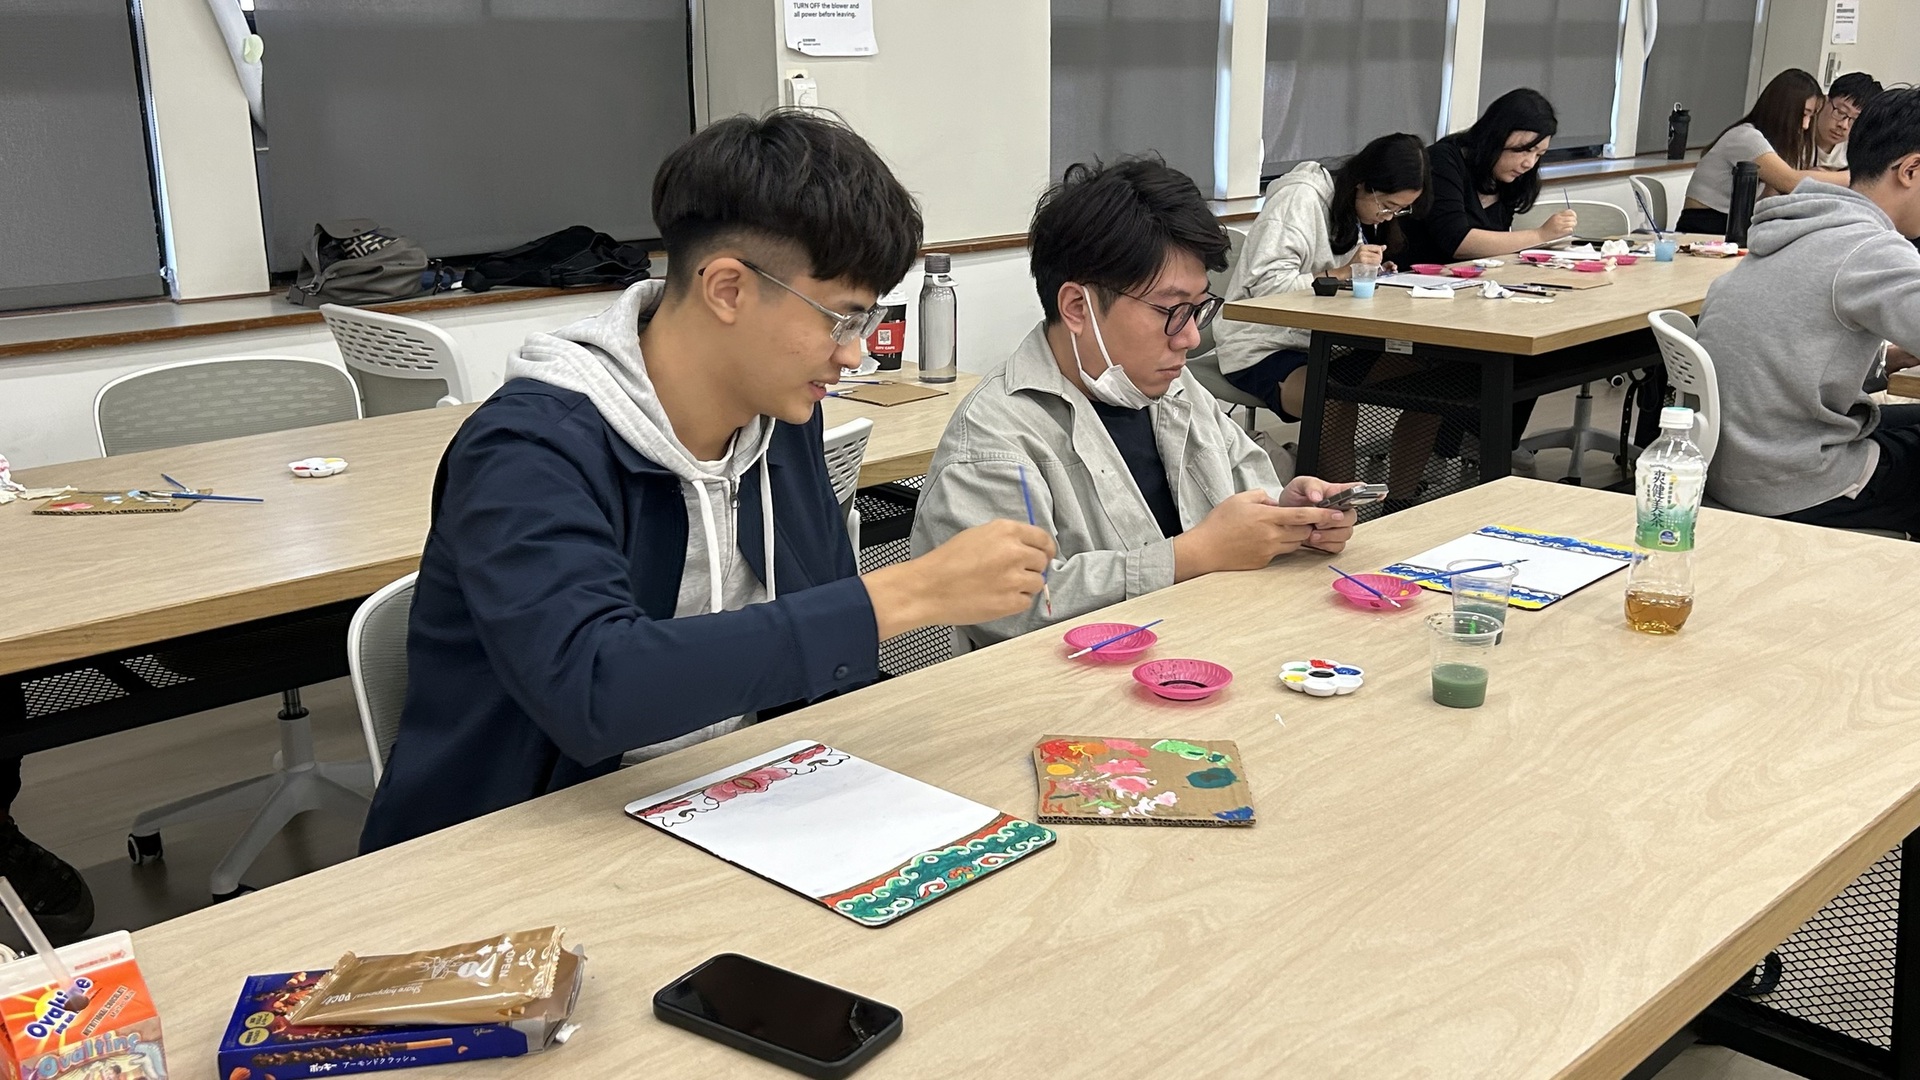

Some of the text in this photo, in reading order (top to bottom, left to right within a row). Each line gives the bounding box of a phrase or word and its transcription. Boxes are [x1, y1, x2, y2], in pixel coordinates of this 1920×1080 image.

[836, 11, 856, 19] leaving.
[1650, 469, 1666, 528] 爽健美茶
[498, 949, 516, 977] OPEN
[398, 986, 422, 994] Share
[82, 1007, 108, 1036] NUTRITIONAL
[38, 1032, 141, 1078] Ovaltine
[309, 1055, 417, 1072] ポッキー アーモンドクラッシュ
